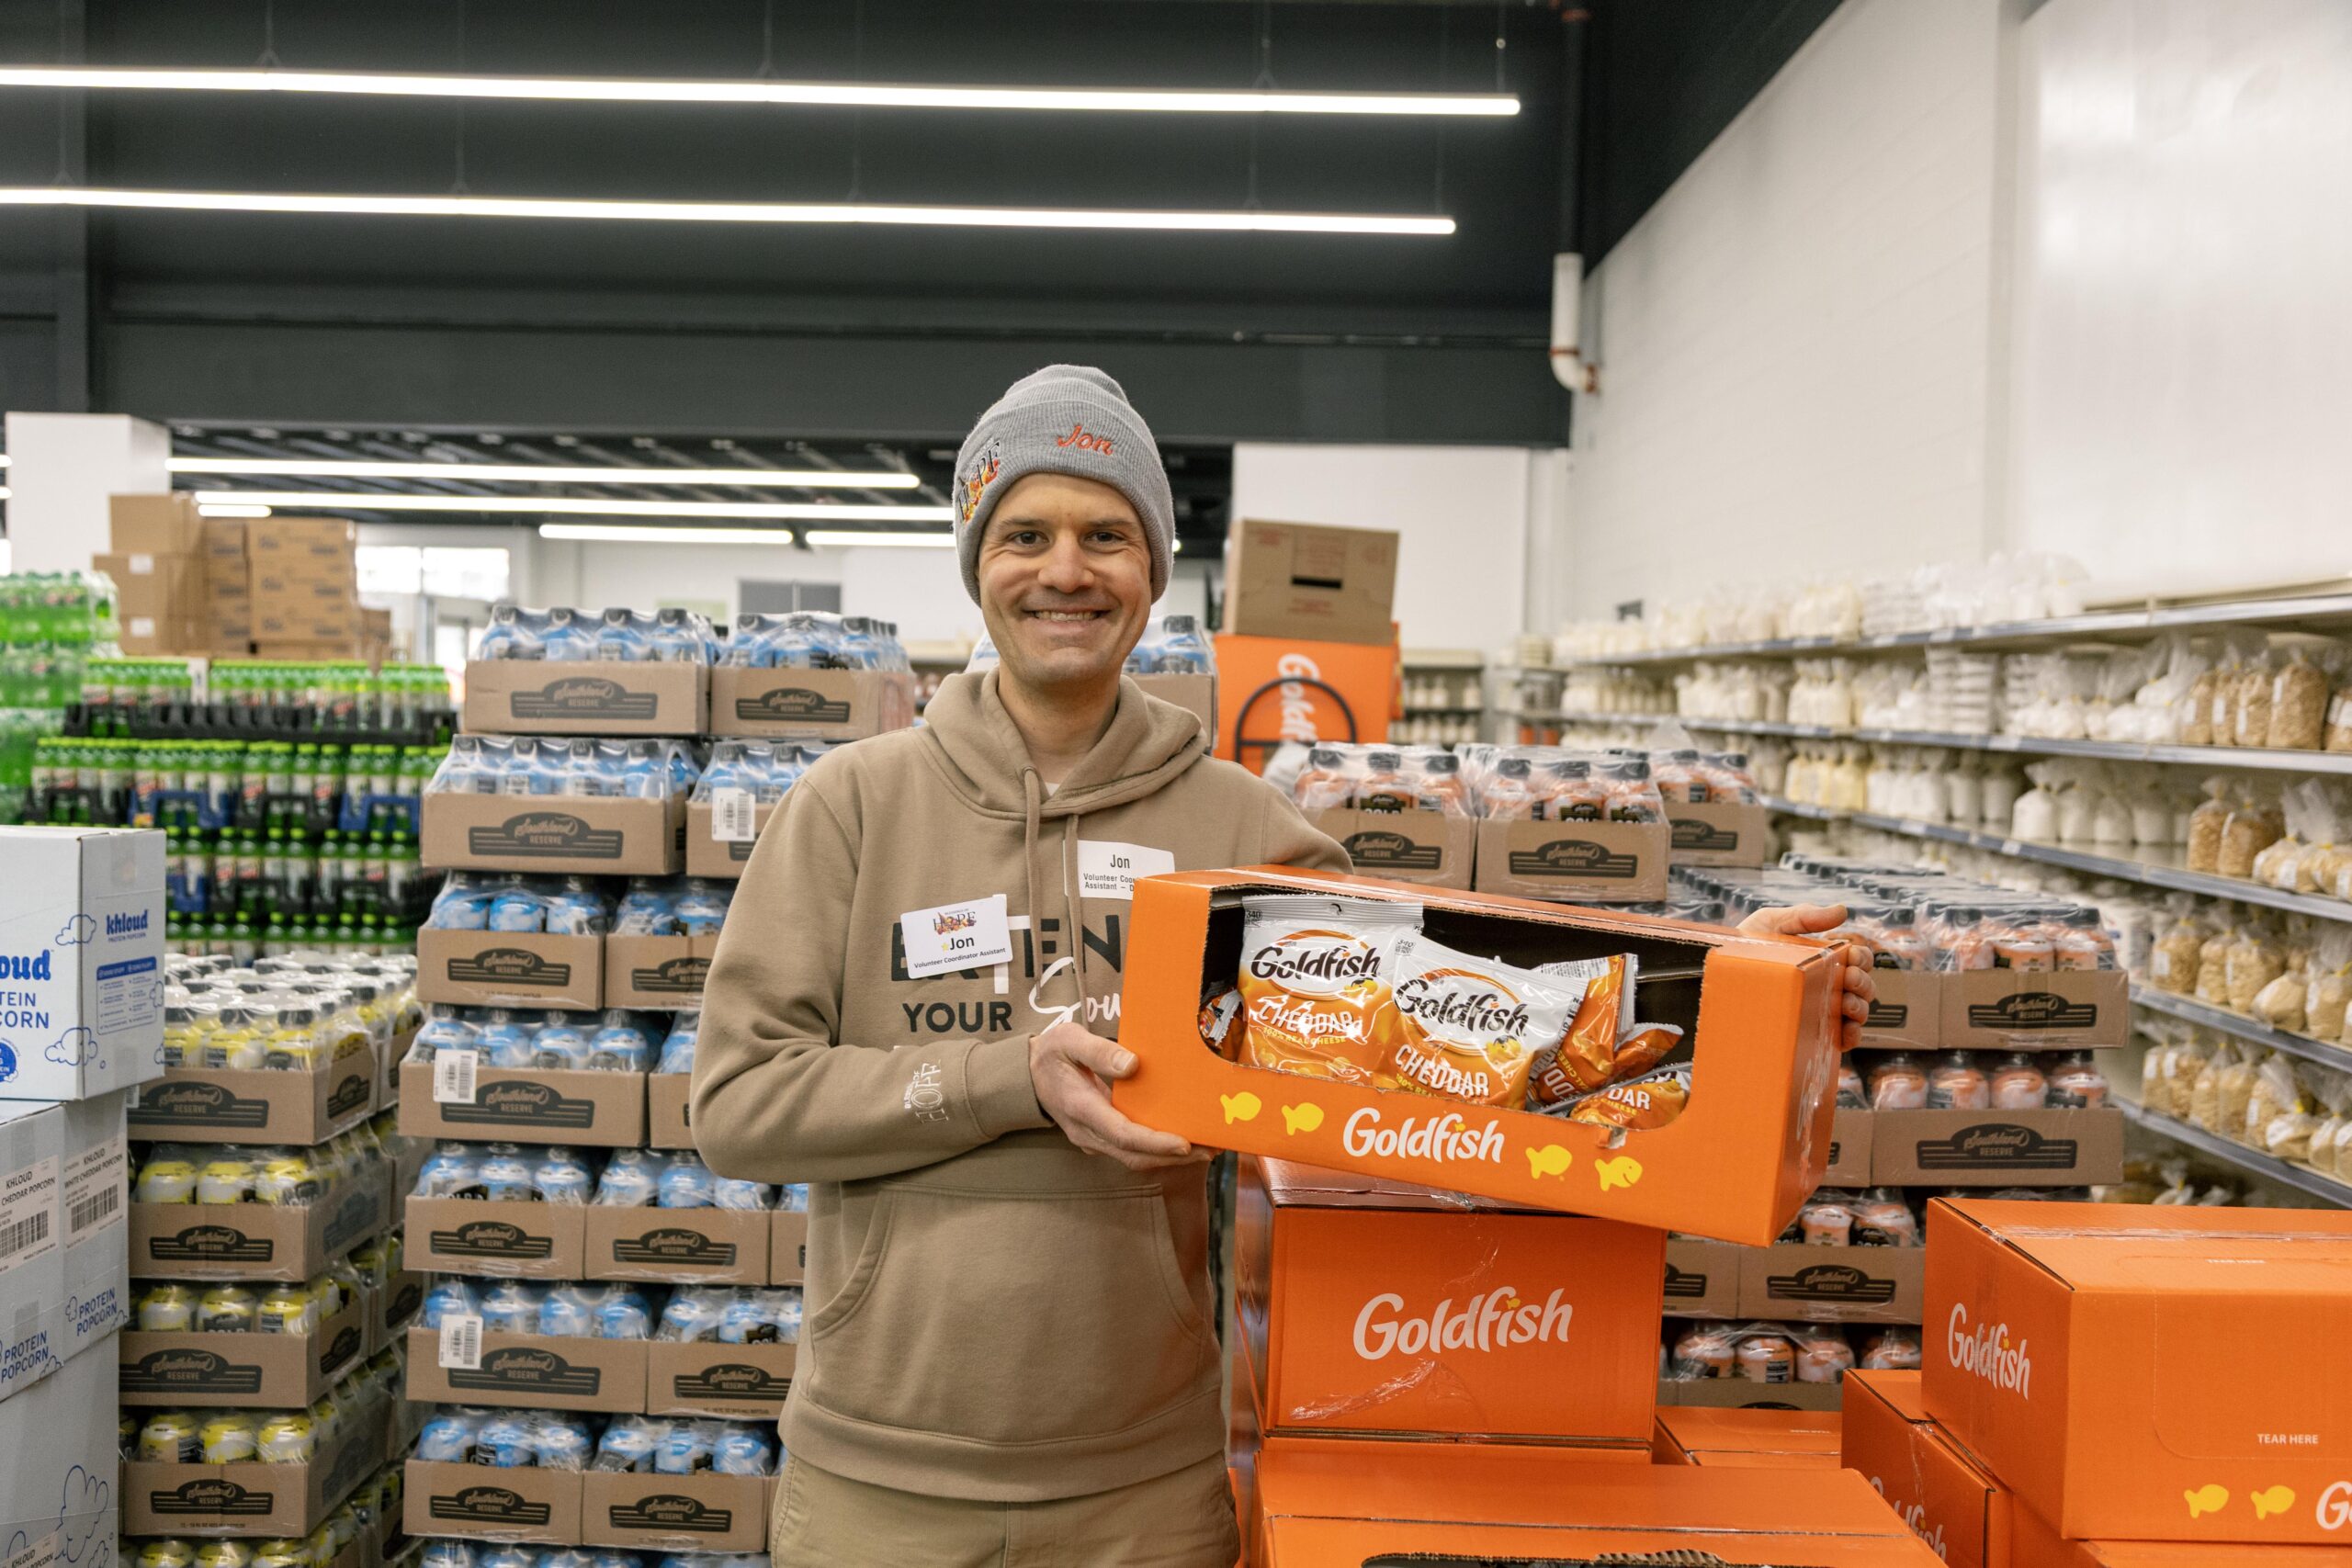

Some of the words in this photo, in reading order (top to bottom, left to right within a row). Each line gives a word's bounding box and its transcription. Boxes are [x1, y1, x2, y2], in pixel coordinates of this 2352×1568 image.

[1057, 425, 1114, 456] Jon
[1110, 854, 1130, 868] Jon
[1083, 873, 1117, 882] Volunteer
[1085, 882, 1117, 890] Assistant
[106, 908, 148, 935] khloud
[1247, 910, 1261, 919] 340
[914, 958, 943, 968] Volunteer
[944, 953, 978, 963] Coordinator
[979, 947, 1006, 956] Assistant
[950, 937, 975, 951] Jon
[1251, 945, 1381, 980] Goldfish
[902, 1001, 1012, 1032] YOUR
[1029, 956, 1121, 1035] Sou
[1395, 978, 1529, 1036] Goldfish
[0, 1010, 49, 1029] ORN
[1259, 1003, 1355, 1034] CHEDDAR
[1310, 1036, 1346, 1044] CHEESE
[1395, 1043, 1489, 1097] CHEDDAR
[911, 1059, 949, 1123] HOPE
[1343, 1107, 1505, 1164] Goldfish
[84, 1147, 106, 1167] KHLOUD
[1, 1188, 28, 1206] CHEDDAR
[28, 1177, 56, 1194] POPCORN
[6, 1171, 33, 1190] KHLOUD
[79, 1286, 116, 1319] PROTEIN
[77, 1302, 118, 1337] POPCORN
[1353, 1286, 1574, 1360] Goldfish
[5, 1330, 47, 1364] PROTEIN
[1948, 1303, 2030, 1401] Goldfish
[1, 1347, 49, 1383] POPCORN
[2256, 1434, 2288, 1444] TEAR
[2289, 1434, 2319, 1445] HERE
[2316, 1481, 2352, 1530] G
